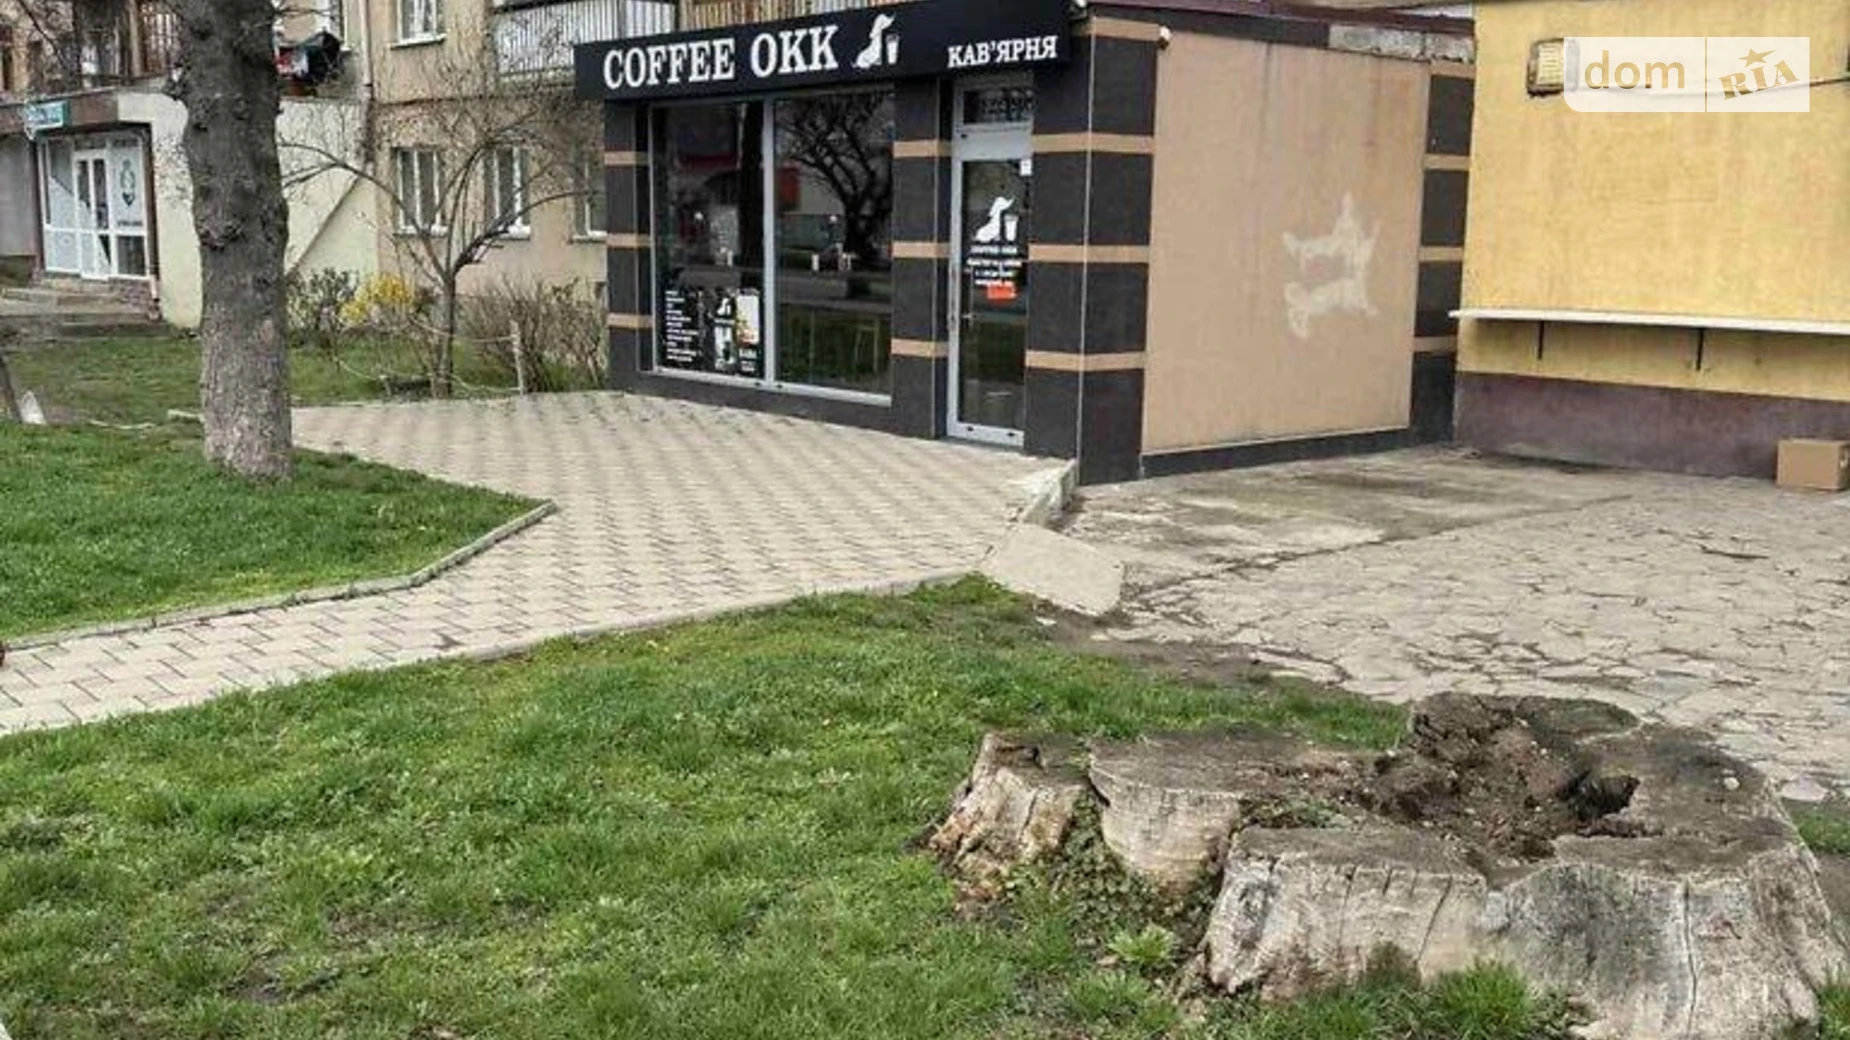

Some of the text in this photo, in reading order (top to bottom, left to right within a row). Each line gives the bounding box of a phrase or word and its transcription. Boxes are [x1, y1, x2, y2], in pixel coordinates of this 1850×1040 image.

[603, 25, 840, 90] COFFEE OKK
[947, 35, 1059, 69] КАВ'ЯРНЯ
